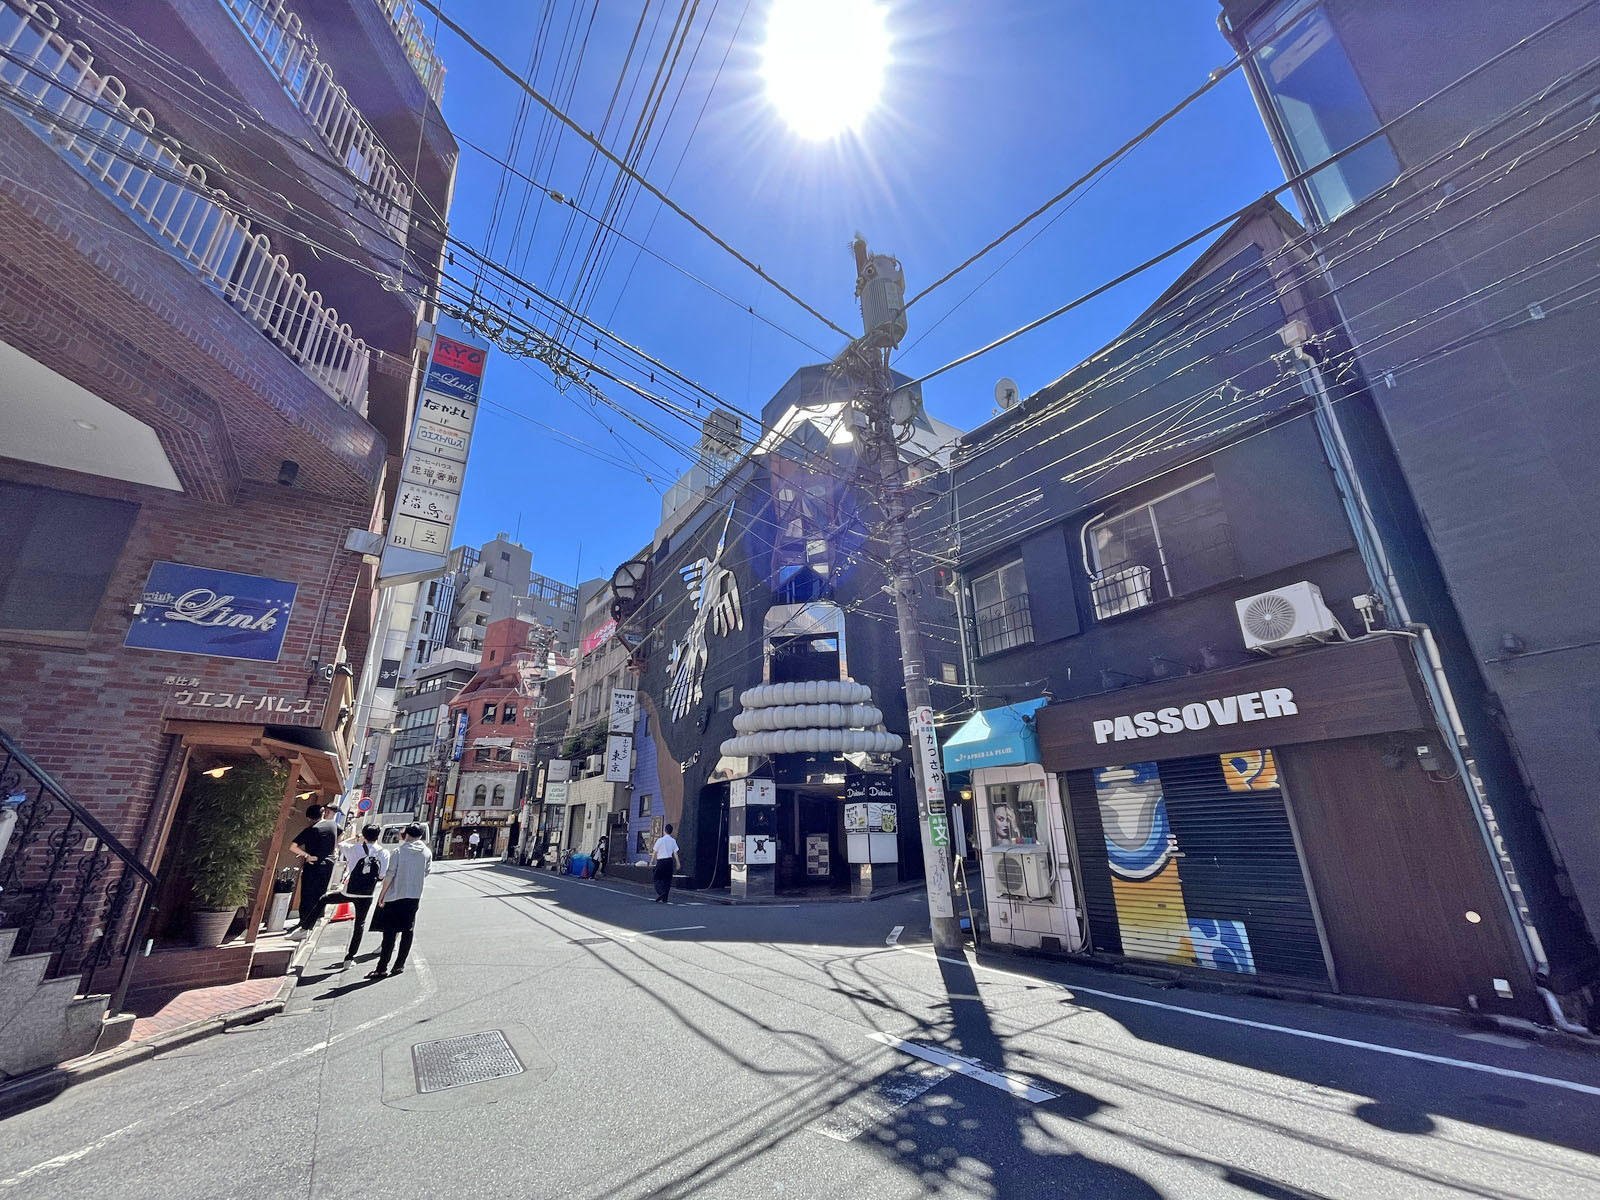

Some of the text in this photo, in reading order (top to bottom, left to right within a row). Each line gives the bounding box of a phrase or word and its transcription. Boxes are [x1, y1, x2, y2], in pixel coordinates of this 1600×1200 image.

[438, 341, 481, 364] RYO
[440, 373, 474, 392] Link
[424, 399, 470, 420] なかよし
[420, 430, 463, 448] ウエストパレス
[434, 446, 443, 454] 1F
[415, 456, 452, 470] コーヒーハウス
[394, 535, 407, 545] B1
[164, 588, 279, 632] Link
[162, 676, 200, 687] 恵比寿
[174, 690, 312, 714] ウエストパレス
[1093, 687, 1299, 744] PASSOVER
[611, 749, 623, 772] 東京
[933, 823, 948, 842] 文
